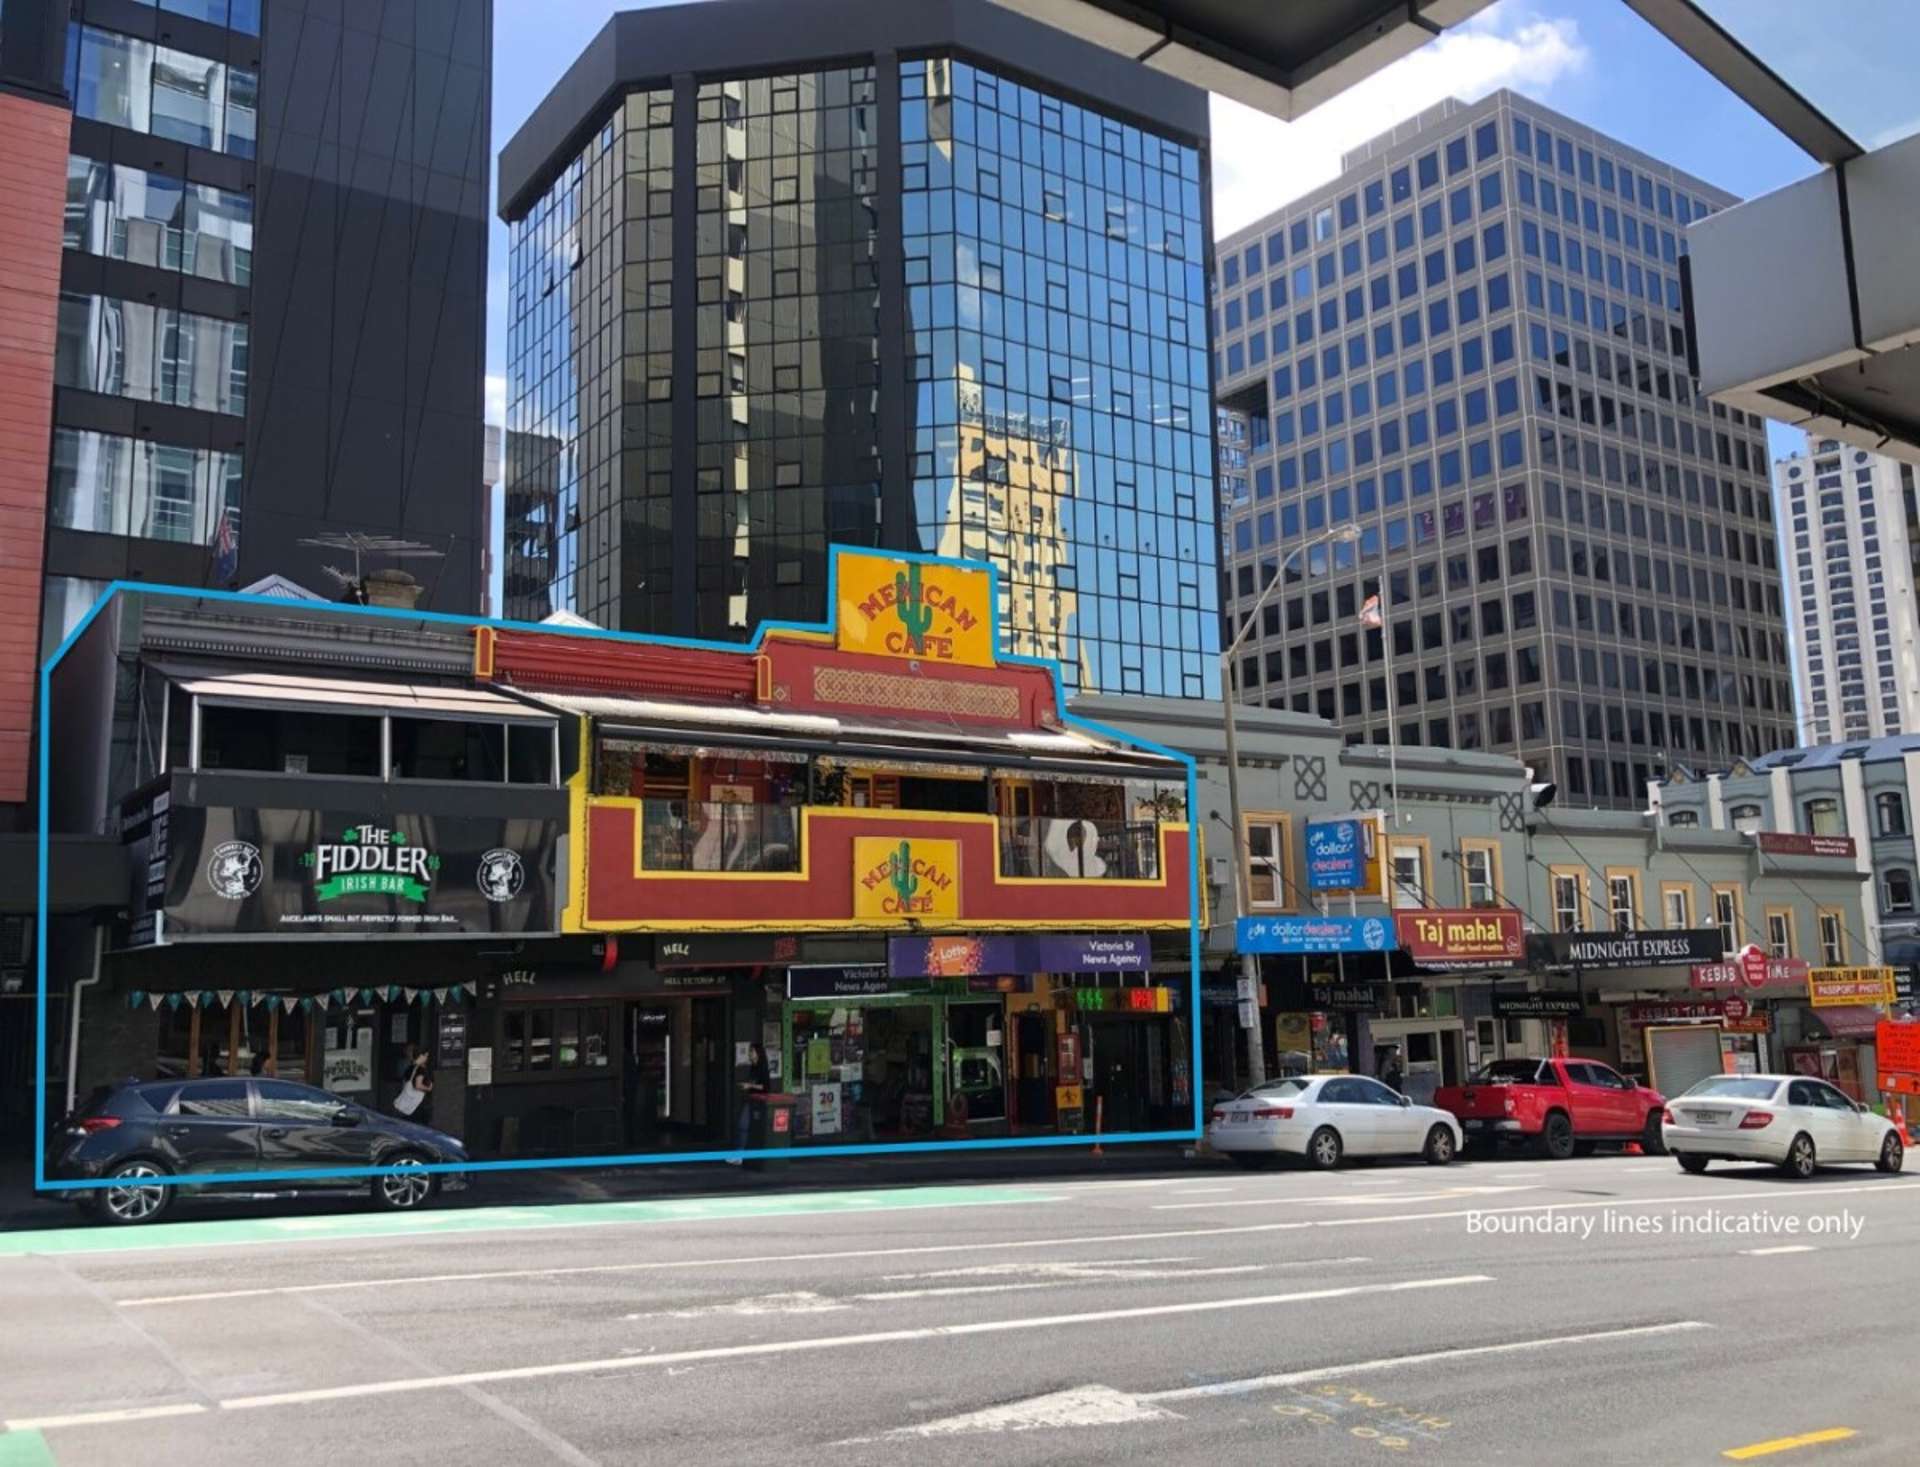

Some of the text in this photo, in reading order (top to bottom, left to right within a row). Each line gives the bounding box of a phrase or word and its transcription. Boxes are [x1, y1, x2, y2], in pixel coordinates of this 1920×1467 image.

[356, 824, 390, 845] THE
[316, 844, 431, 881] FIDDLER
[341, 876, 405, 892] IRISH BAR
[1415, 918, 1444, 947] Taj
[1447, 917, 1503, 941] mahal
[663, 943, 690, 957] HELL
[940, 945, 968, 960] Lotto
[1088, 940, 1135, 952] Victoria St
[1569, 938, 1690, 960] MIDNIGHT EXPRESS
[1082, 953, 1142, 967] News Agency
[502, 970, 537, 986] HELL
[843, 968, 879, 979] Victoria
[1700, 966, 1736, 983] KEBAB
[835, 982, 888, 993] News Agen
